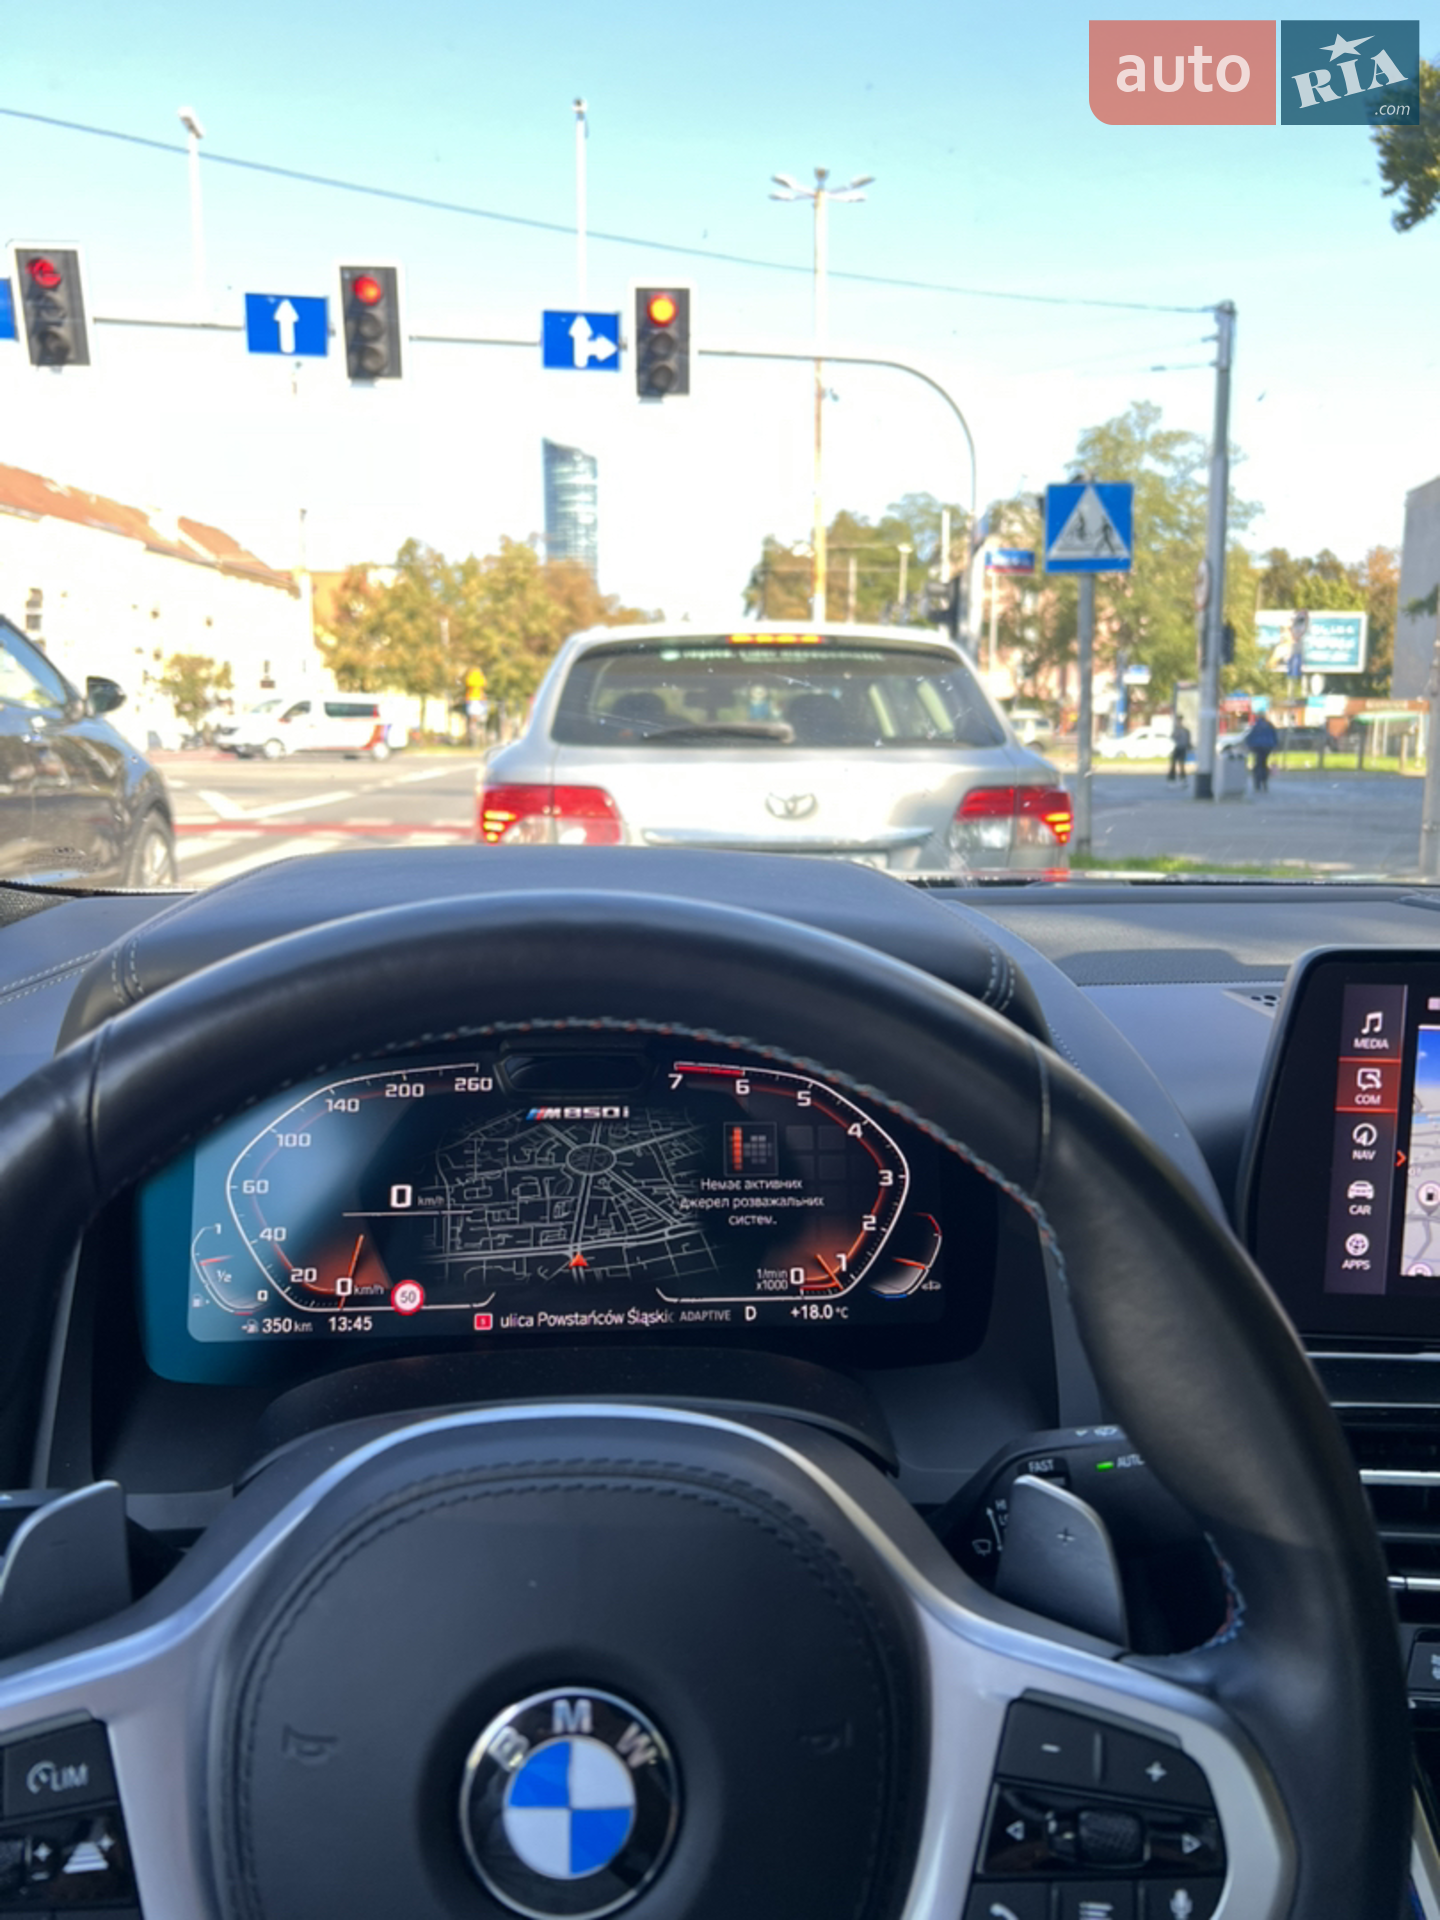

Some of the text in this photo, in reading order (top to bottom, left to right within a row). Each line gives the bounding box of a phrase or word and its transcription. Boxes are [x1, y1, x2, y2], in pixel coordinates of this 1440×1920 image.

[1354, 1038, 1389, 1050] MEDIA
[454, 1077, 493, 1092] 260
[668, 1074, 683, 1089] 7
[735, 1079, 750, 1095] 6
[385, 1083, 425, 1098] 200
[325, 1098, 360, 1113] 140
[797, 1091, 811, 1106] 5
[1355, 1094, 1381, 1106] COM
[847, 1123, 863, 1138] 4
[276, 1133, 311, 1148] 100
[1352, 1150, 1377, 1161] NAV
[701, 1178, 803, 1191] Немає активних
[879, 1170, 893, 1186] 3
[242, 1180, 269, 1194] 60
[390, 1184, 413, 1208] 0
[732, 1196, 825, 1209] розважальних
[1349, 1205, 1372, 1216] CAR
[214, 1223, 222, 1235] 1
[862, 1215, 877, 1231] 2
[259, 1227, 287, 1241] 40
[836, 1254, 848, 1271] 1
[1342, 1259, 1371, 1271] APPS
[290, 1268, 317, 1283] 20
[756, 1268, 788, 1280] 1/min
[790, 1267, 805, 1285] 0
[336, 1278, 385, 1297] 0 km/h
[756, 1280, 788, 1291] x1000
[257, 1290, 268, 1302] 0
[400, 1290, 417, 1303] 50
[500, 1313, 534, 1328] ulica
[537, 1309, 625, 1328] Powstańców
[679, 1309, 731, 1322] ADAPTIVE
[745, 1306, 757, 1321] D
[790, 1304, 833, 1320] +18.0
[262, 1318, 314, 1334] 350 km
[328, 1316, 374, 1332] 13:45
[1028, 1458, 1055, 1472] FAST
[486, 1697, 657, 1773] BMW
